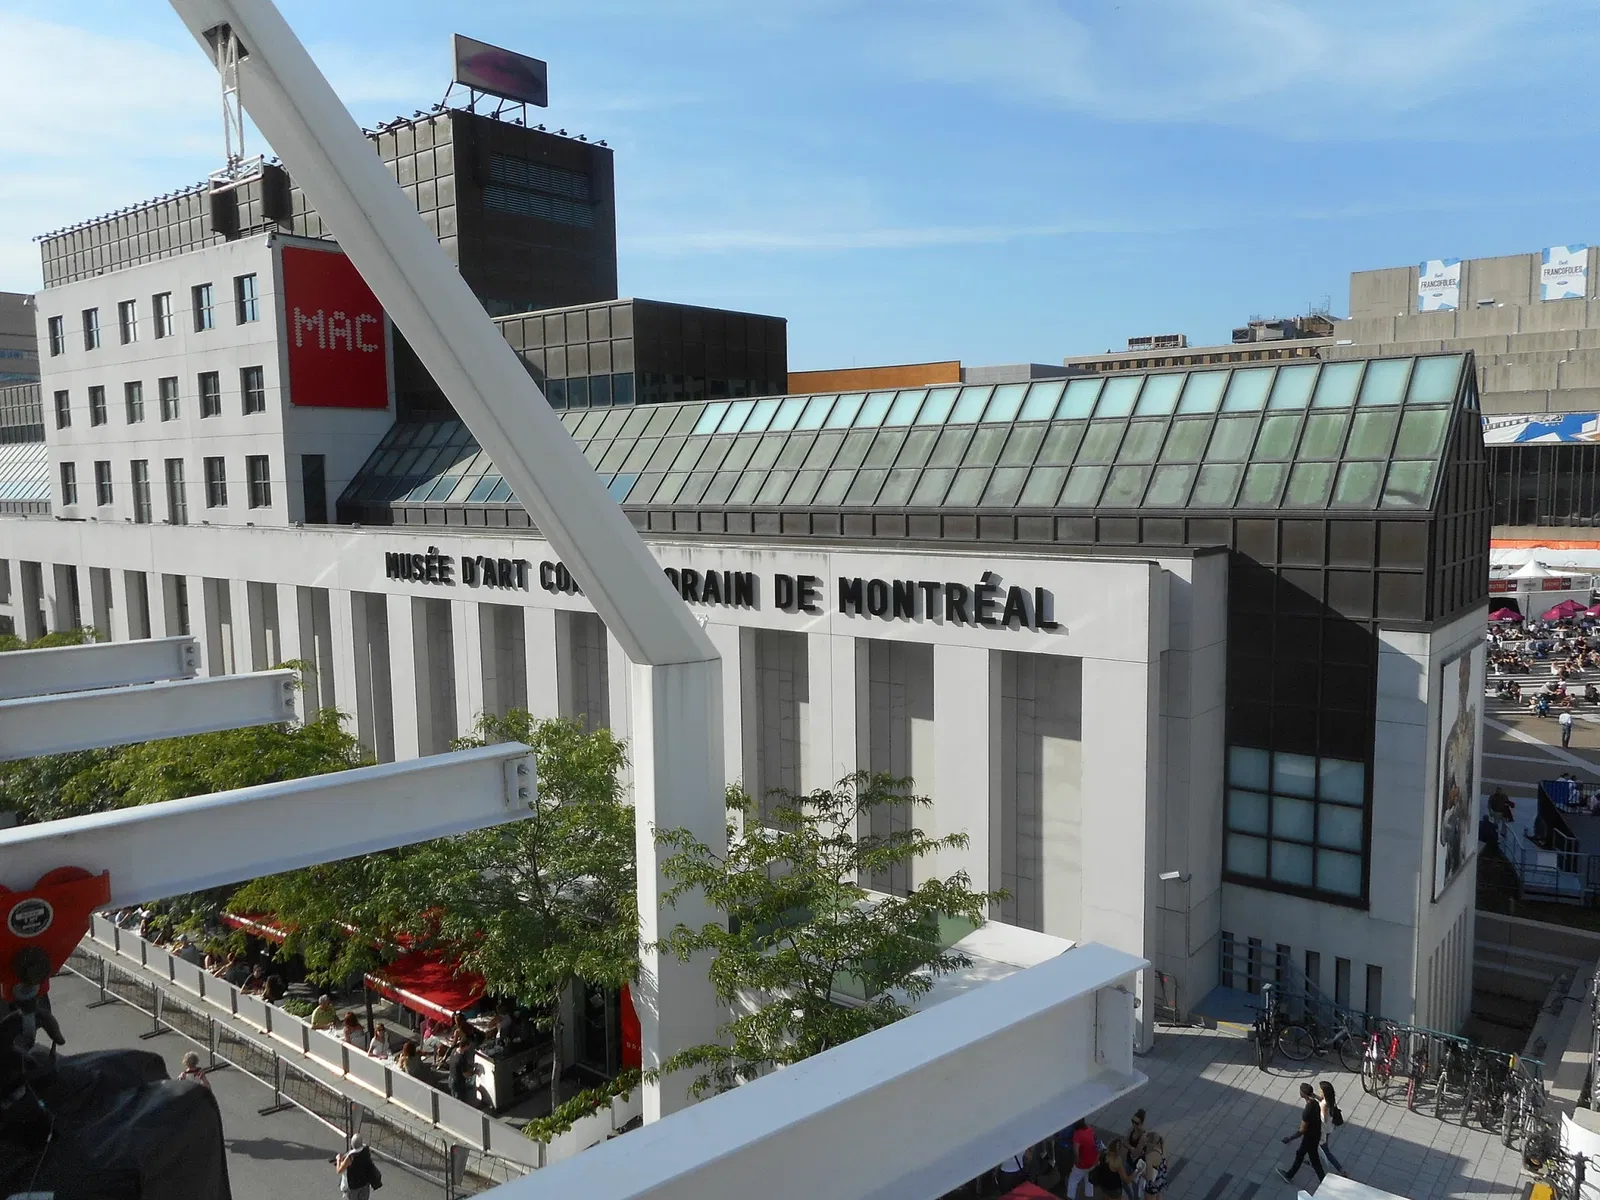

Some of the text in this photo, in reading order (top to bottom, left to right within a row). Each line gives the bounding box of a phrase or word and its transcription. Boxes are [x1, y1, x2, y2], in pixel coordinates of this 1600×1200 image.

[1421, 279, 1456, 288] FRANCOFOLIES
[1543, 266, 1582, 276] FRANCOFOLIES
[294, 307, 378, 352] MAC
[385, 545, 452, 582] MUSÉE
[462, 555, 528, 588] D'ART
[774, 573, 816, 611] DE
[838, 570, 1059, 630] MONTRÉAL
